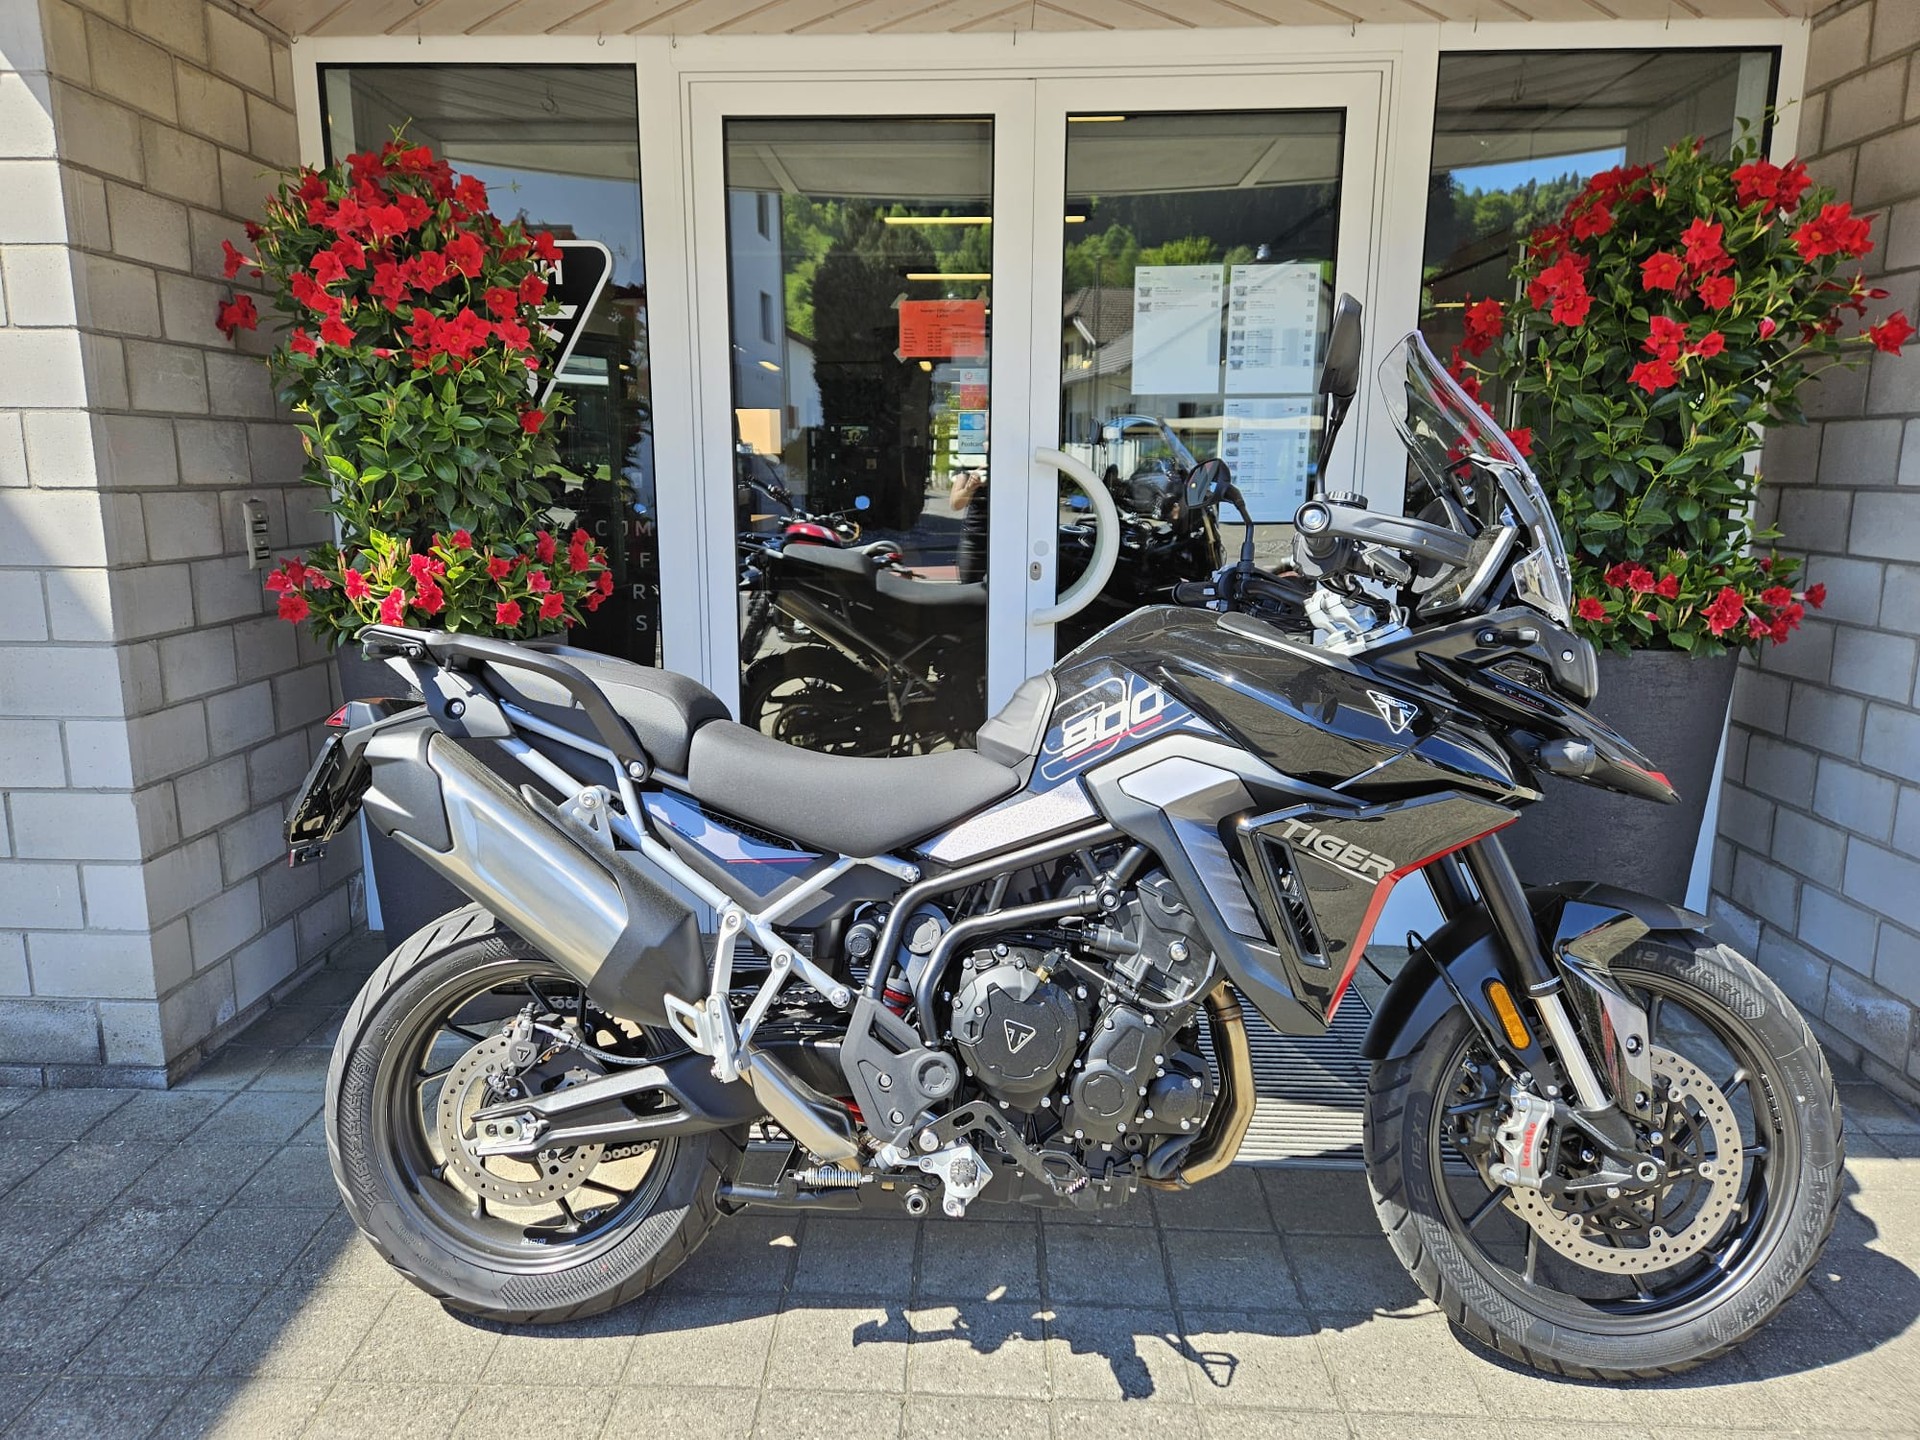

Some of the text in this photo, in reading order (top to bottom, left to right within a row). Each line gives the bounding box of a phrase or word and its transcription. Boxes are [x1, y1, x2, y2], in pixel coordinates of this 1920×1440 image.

[1062, 686, 1165, 758] 900
[1281, 817, 1396, 879] TIGER
[1520, 1122, 1537, 1168] brembo
